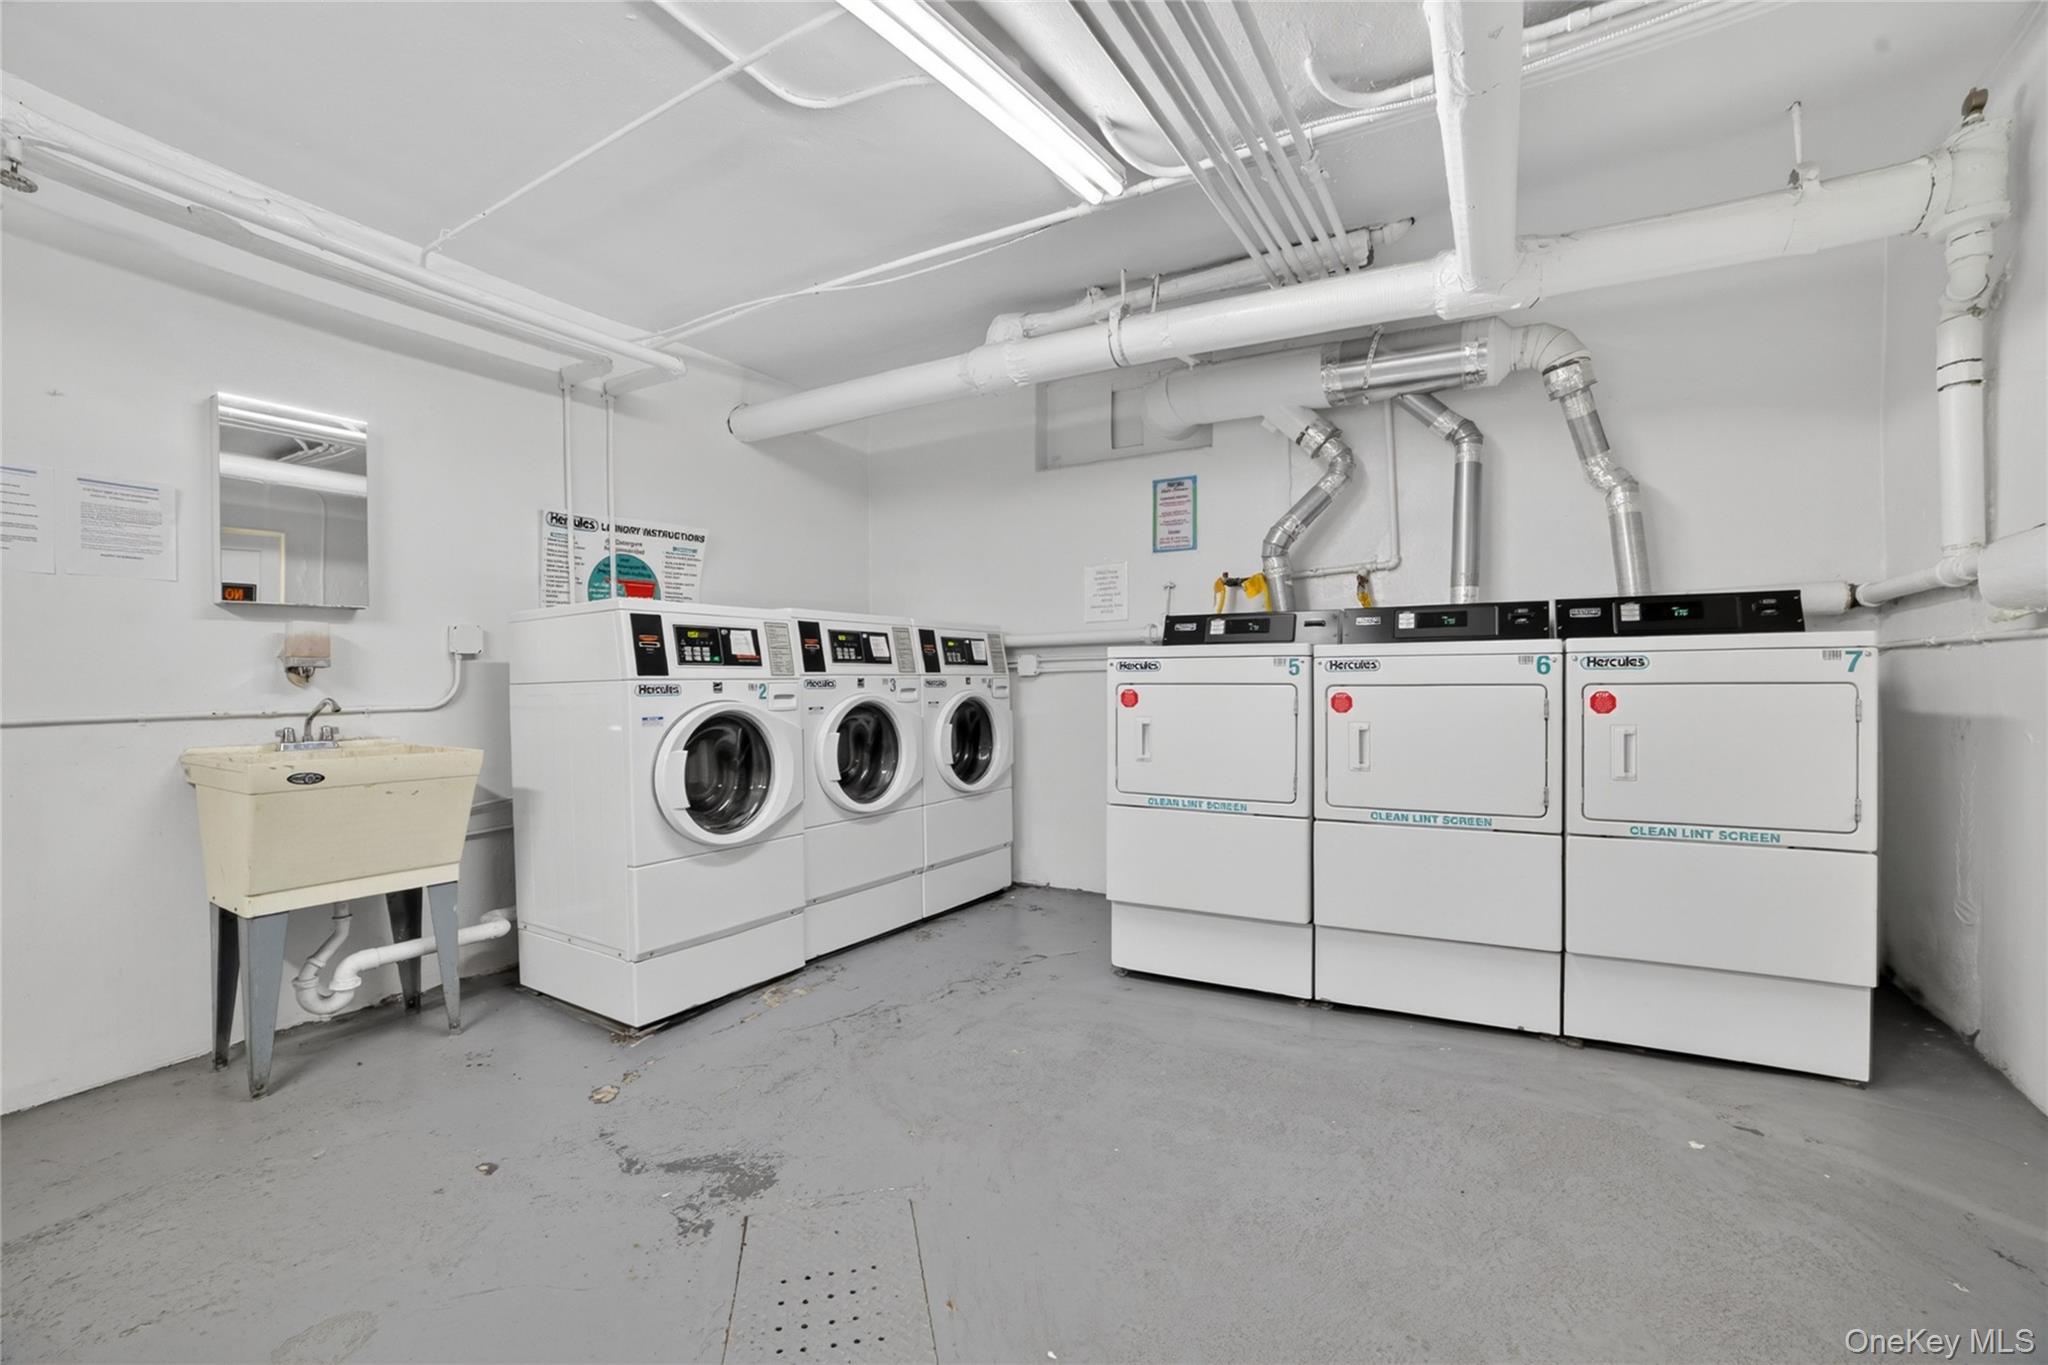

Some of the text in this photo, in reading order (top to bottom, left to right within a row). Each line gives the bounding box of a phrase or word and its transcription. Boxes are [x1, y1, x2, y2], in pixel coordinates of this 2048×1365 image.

[550, 512, 596, 530] Herules
[643, 528, 706, 543] INSTRUCTIONS
[1289, 657, 1300, 676] 5
[1329, 660, 1378, 670] Hercules
[1536, 655, 1551, 675] 6
[1586, 655, 1646, 668] Hercules
[1845, 650, 1864, 673] 7
[758, 683, 767, 700] 2
[889, 678, 897, 693] 3
[1147, 797, 1248, 811] CLEAN LINT SCREEN
[1370, 811, 1493, 827] CLEAN LINT SCREEN
[1629, 825, 1782, 843] CLEAN LINT SCREEN
